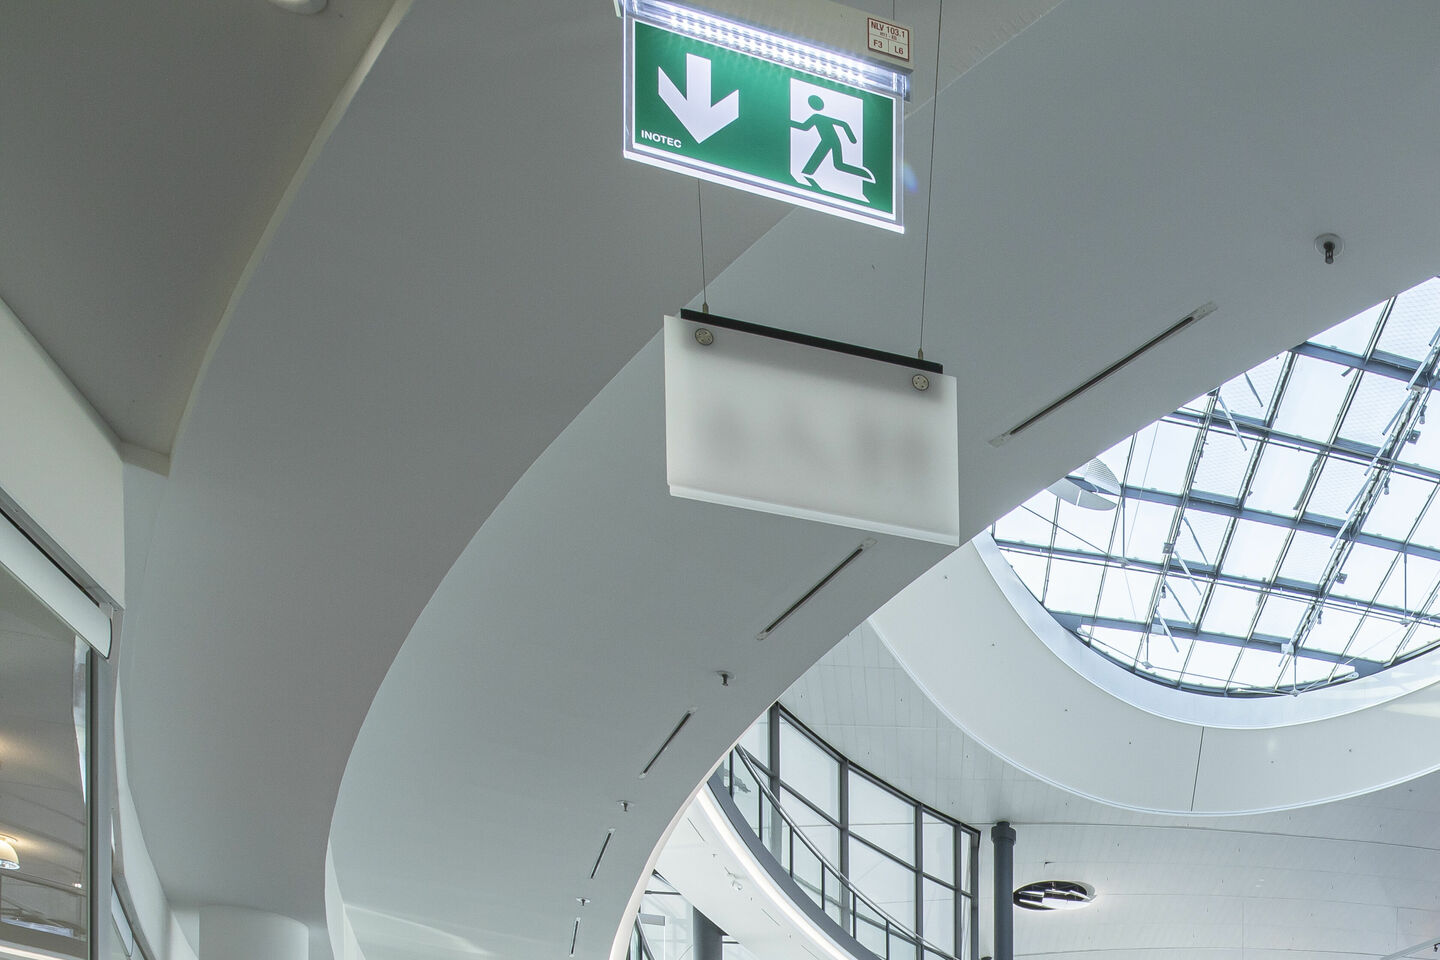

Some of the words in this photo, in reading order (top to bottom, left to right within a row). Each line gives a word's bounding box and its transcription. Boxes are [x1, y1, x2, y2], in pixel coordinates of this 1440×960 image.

[871, 21, 884, 31] NLV
[887, 26, 905, 38] 103.1
[873, 40, 883, 48] F3
[641, 129, 682, 148] INOTEC
